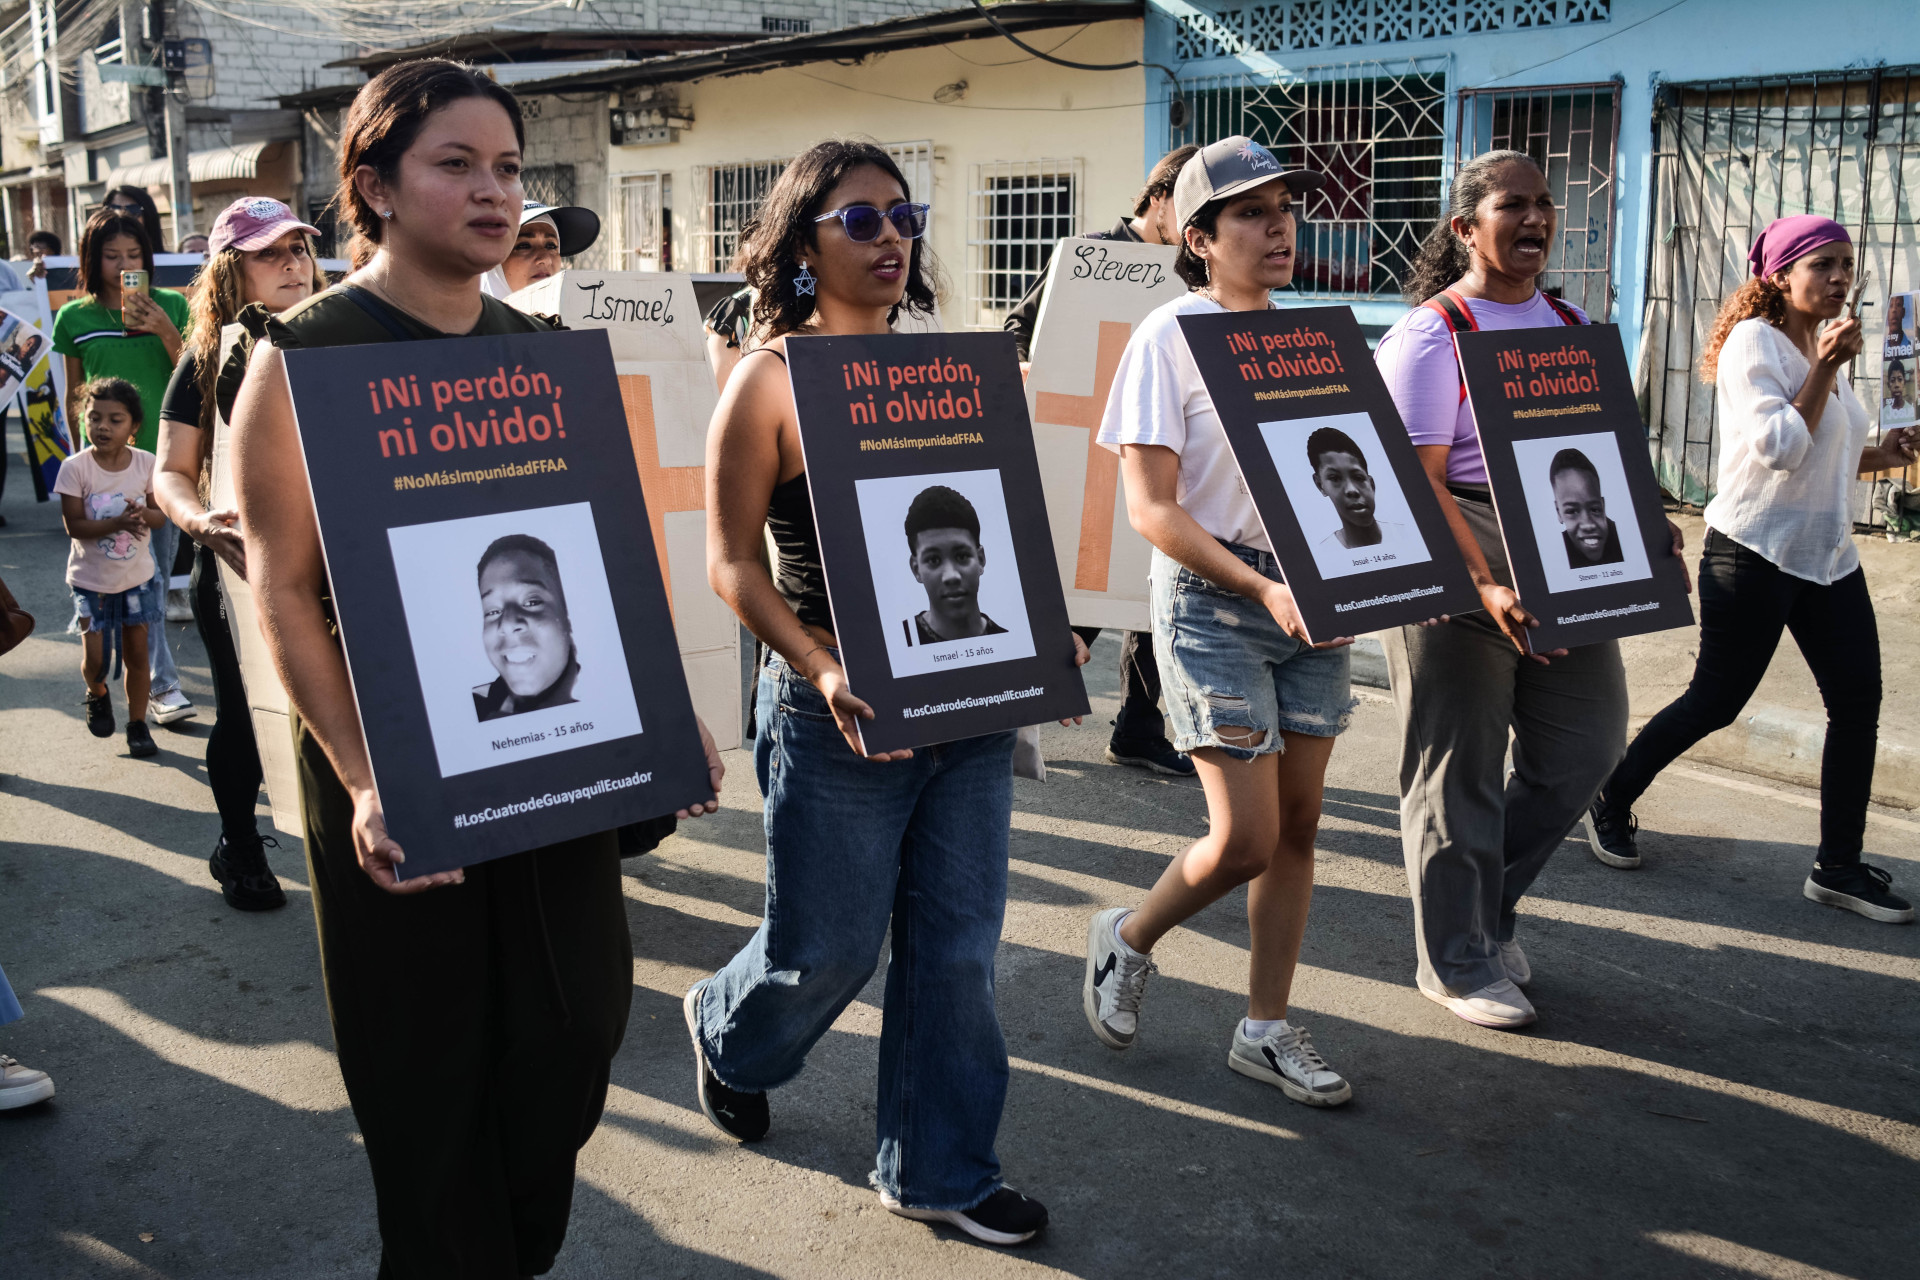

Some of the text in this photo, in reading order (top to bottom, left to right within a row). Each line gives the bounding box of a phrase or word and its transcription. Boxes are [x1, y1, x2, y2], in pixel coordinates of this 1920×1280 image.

[1070, 245, 1166, 288] Steven
[576, 280, 674, 327] Ismael
[1226, 326, 1336, 355] ¡Ni perdón,
[1884, 339, 1914, 358] Ismael
[842, 356, 981, 392] ¡Ni perdón,
[1238, 350, 1345, 381] ni olvido!
[1496, 344, 1597, 373] ¡Ni perdón,
[368, 364, 562, 415] ¡Ni perdón,
[1254, 383, 1351, 401] #NoMásImpunidadFFAA
[1503, 368, 1601, 399] ni olvido!
[849, 388, 984, 425] ni olvido!
[1513, 403, 1602, 420] #NoMásImpunidadFFAA
[378, 402, 567, 458] ni olvido!
[860, 432, 984, 452] #NoMásImpunidadFFAA
[394, 457, 568, 491] #NoMásImpunidadFFAA
[1352, 556, 1369, 566] Josué
[1382, 553, 1396, 561] años
[1579, 574, 1598, 582] Steven
[1610, 569, 1623, 577] años
[1334, 585, 1444, 613] #LosCuatrodeGuayaquilEcuador
[1557, 600, 1660, 625] #LosCuatrodeGuayaquilEcuador
[933, 651, 959, 663] Ismael
[965, 649, 975, 658] 15
[976, 646, 994, 656] años
[902, 685, 1045, 719] #LosCuatrodeGuayaquilEcuador
[491, 731, 546, 751] Nehemias
[554, 726, 568, 738] 15
[570, 720, 594, 734] años
[453, 771, 653, 829] #LosCuatrodeGuayaquilEcuador
